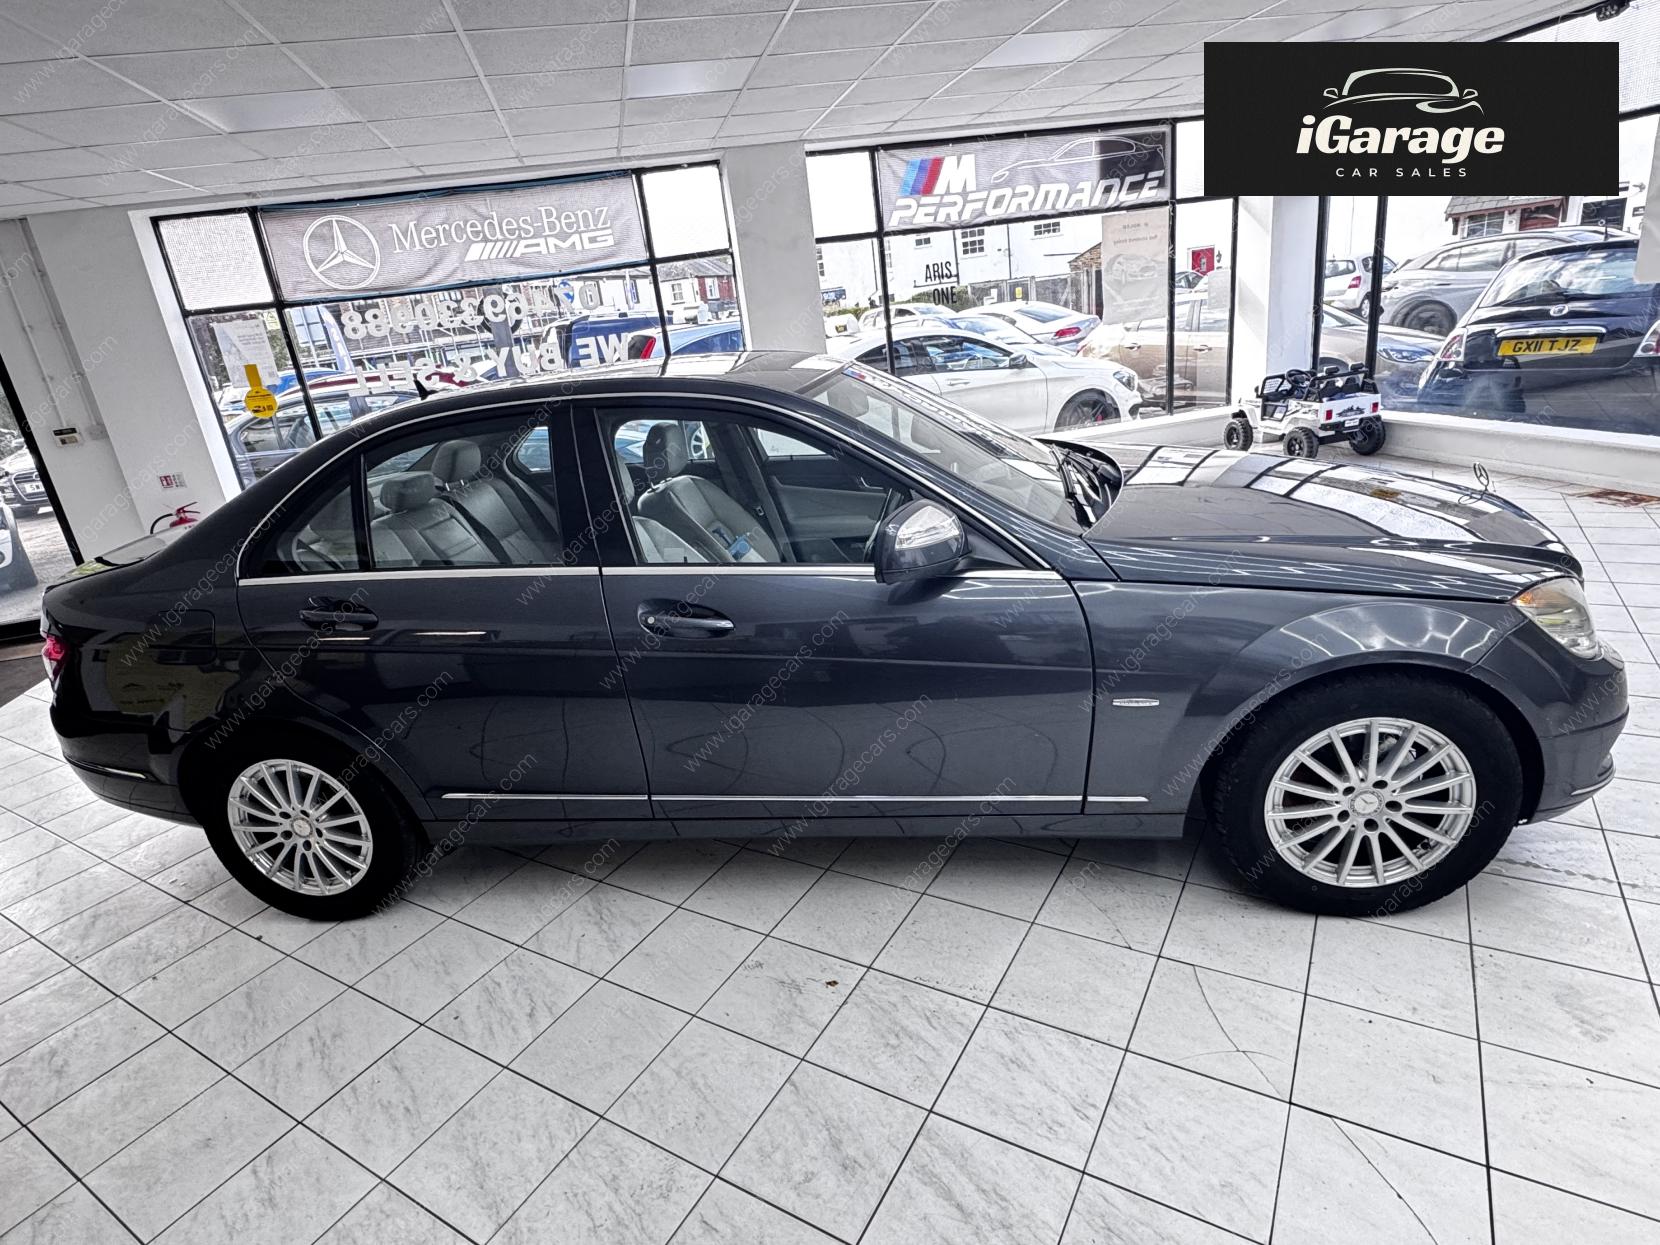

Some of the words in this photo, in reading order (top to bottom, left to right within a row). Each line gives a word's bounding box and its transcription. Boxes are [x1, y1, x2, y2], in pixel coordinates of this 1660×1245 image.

[888, 170, 1164, 227] PERFORMANCE
[388, 206, 611, 253] Mercedes-Benz
[925, 261, 953, 282] ARIS
[933, 286, 958, 306] ONE
[1512, 341, 1543, 353] GX11
[1549, 339, 1581, 351] TJZ
